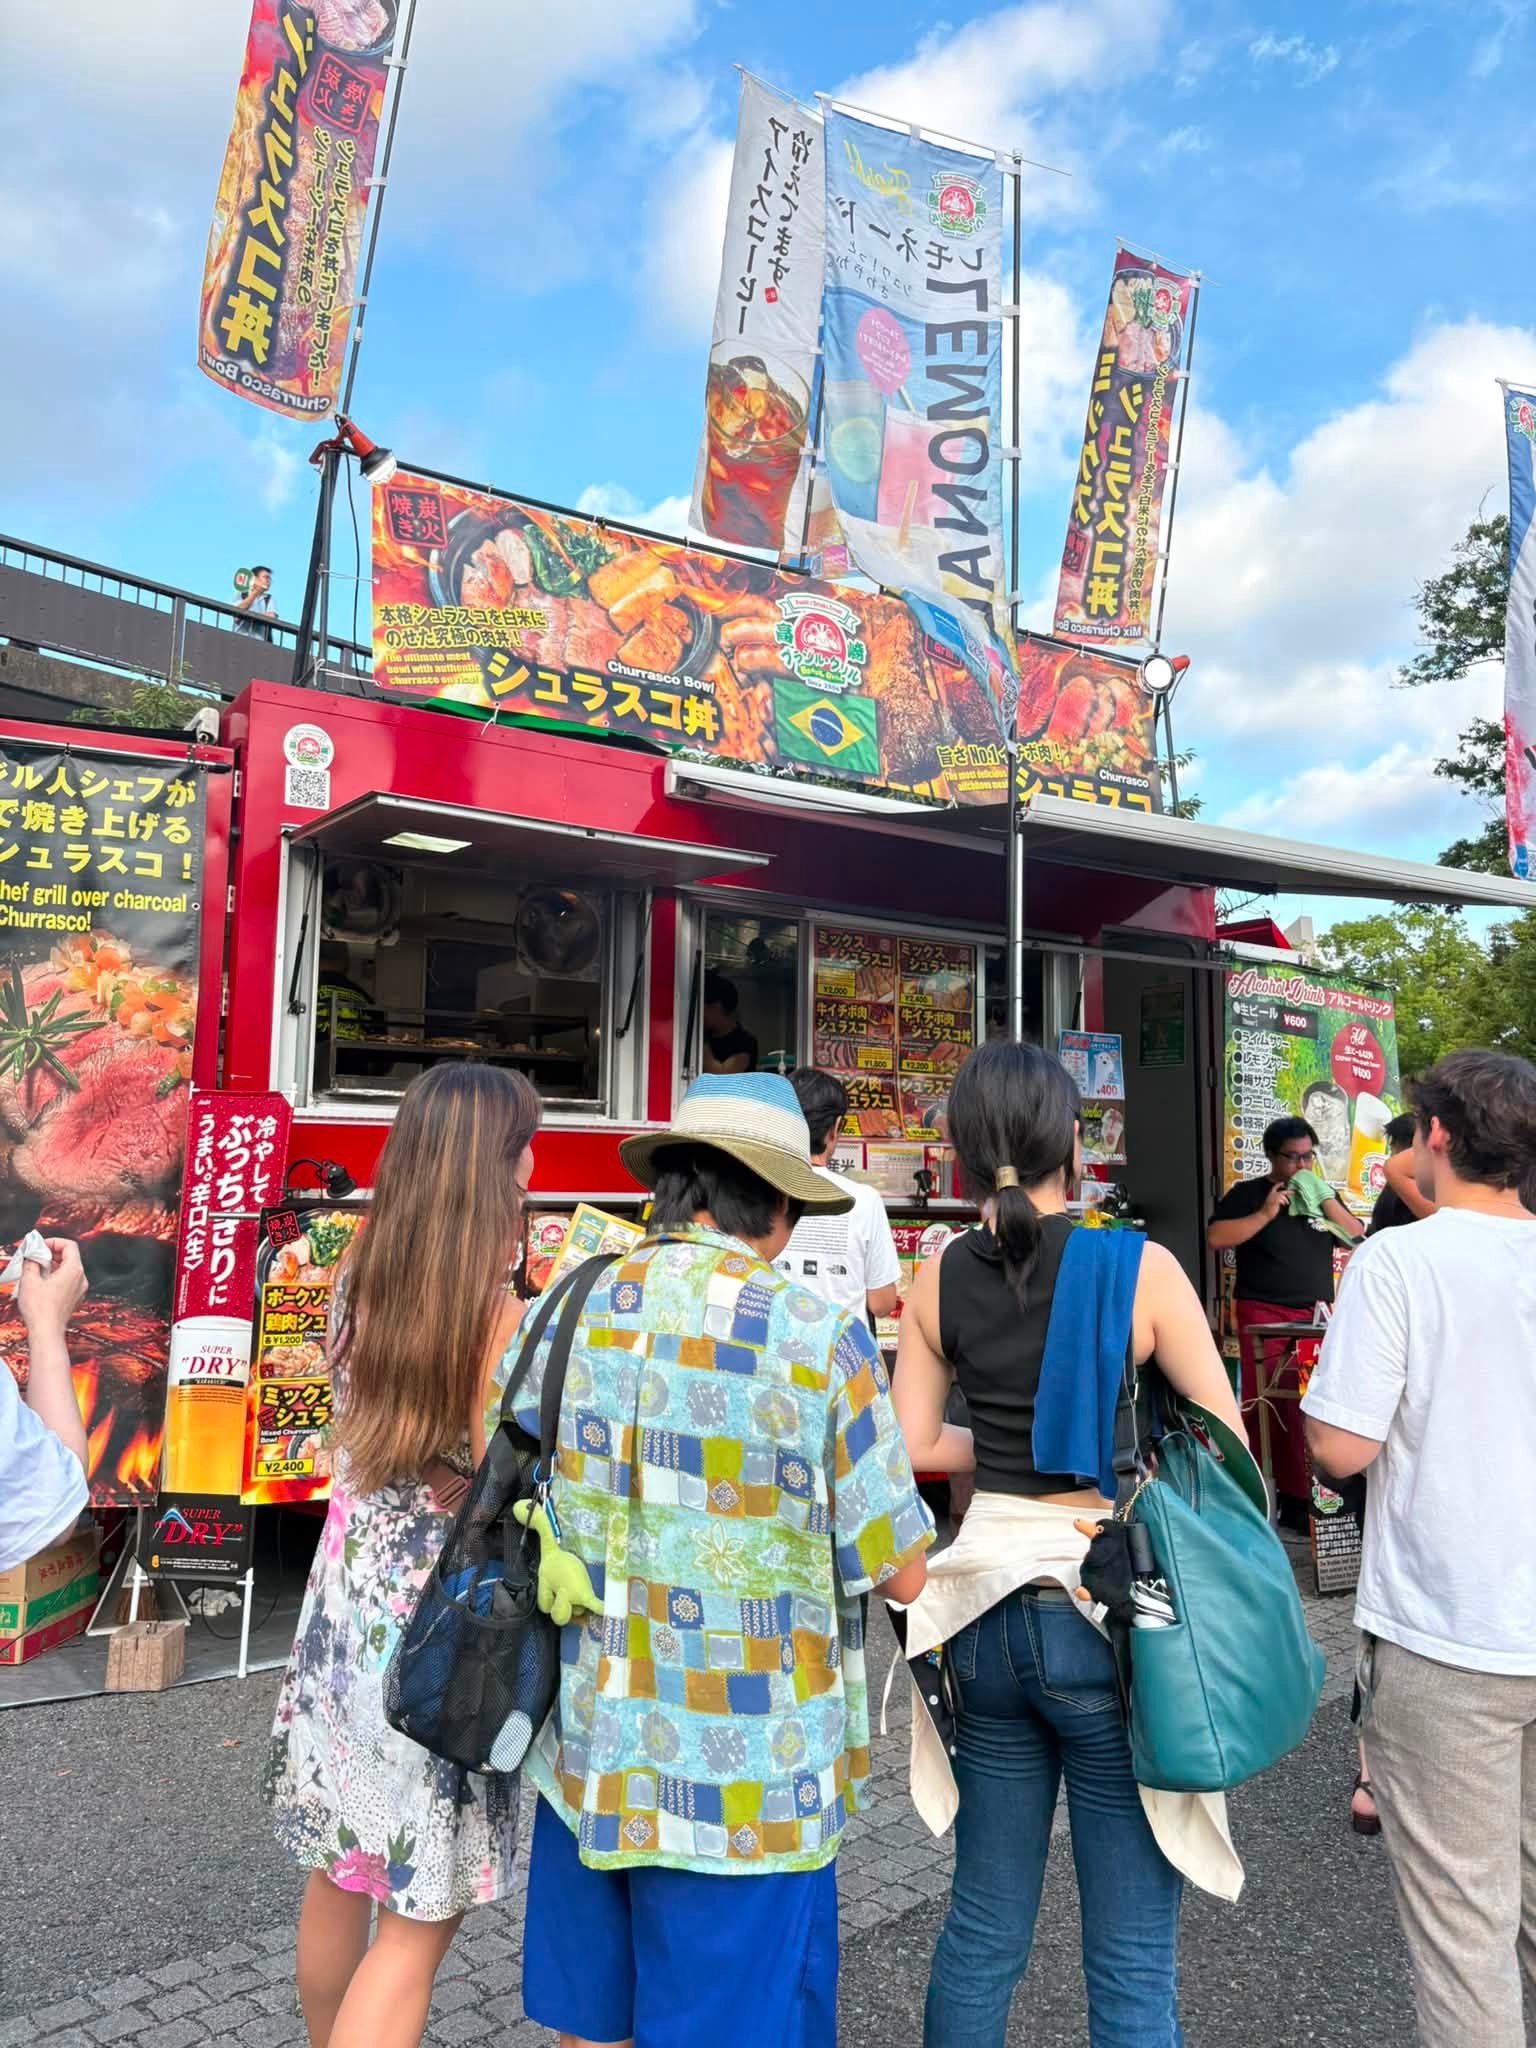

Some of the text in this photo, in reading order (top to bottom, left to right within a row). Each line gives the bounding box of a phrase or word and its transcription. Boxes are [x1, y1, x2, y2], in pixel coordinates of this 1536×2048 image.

[392, 494, 415, 538] 焼き
[417, 497, 440, 540] 炭火
[380, 604, 547, 628] 本格シュラスコを白米に
[385, 628, 523, 648] のせた究極の肉丼！
[607, 660, 716, 695] Churrasco Bowl
[488, 652, 720, 743] シュラスコ丼
[0, 762, 197, 808] ル人シェフが
[1099, 769, 1149, 789] Churrasco
[0, 880, 187, 912] hef grill over charcoal
[1228, 970, 1325, 1006] Alcohol Drink
[1284, 1014, 1306, 1028] ¥600
[902, 1079, 952, 1097] シュラス
[250, 1115, 278, 1204] 冷やして
[209, 1114, 256, 1307] ぶっちぎりに
[200, 1345, 233, 1355] SUPER
[273, 1335, 301, 1345] ¥1,200
[276, 1406, 334, 1428] シュラ
[265, 1460, 304, 1473] ¥2,400
[182, 1508, 222, 1520] SUPER
